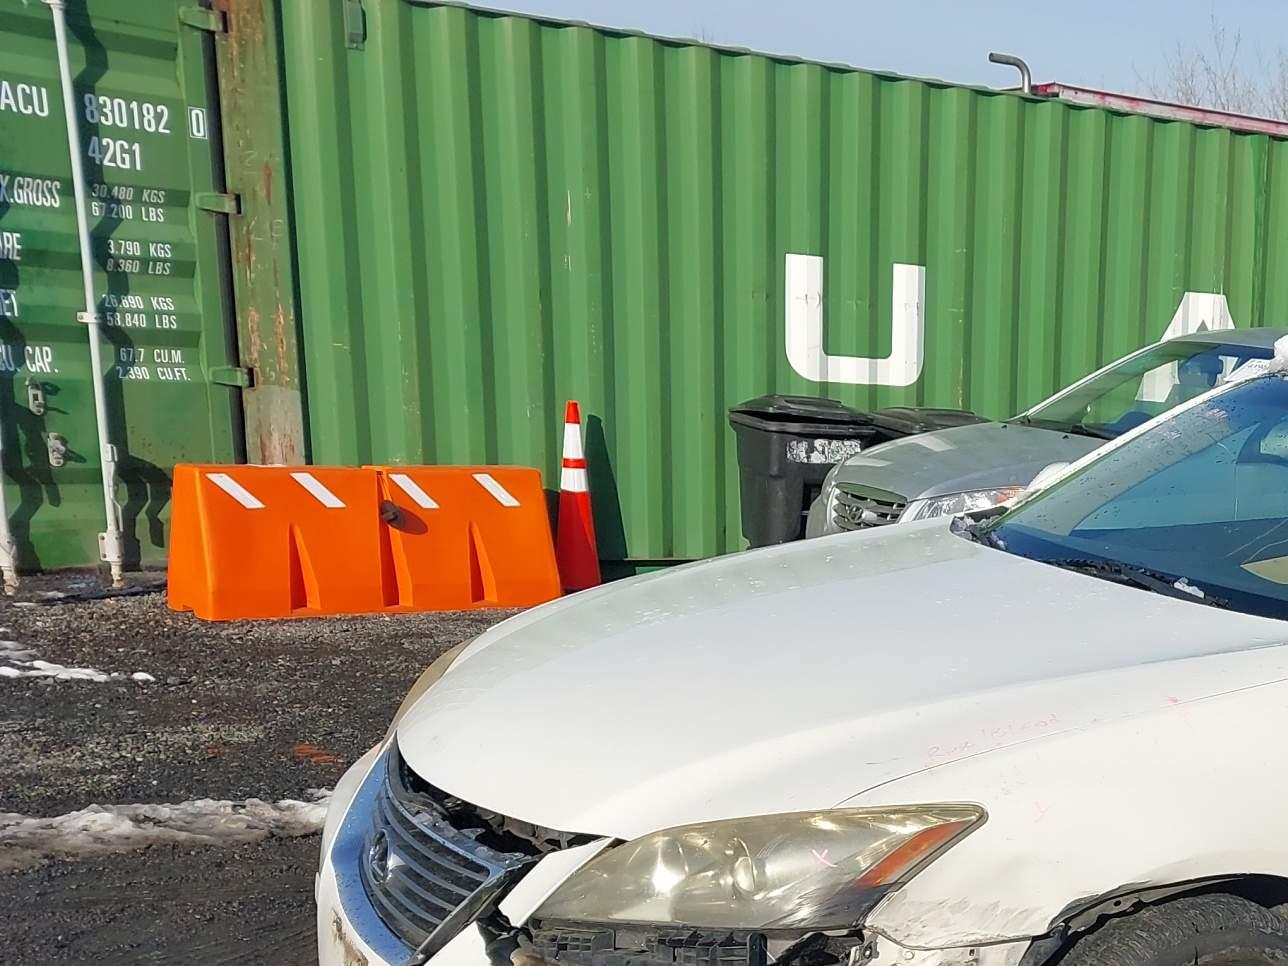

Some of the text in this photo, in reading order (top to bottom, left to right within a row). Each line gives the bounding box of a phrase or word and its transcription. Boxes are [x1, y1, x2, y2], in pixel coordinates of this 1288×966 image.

[0, 80, 206, 138] ACU 830182 0
[87, 135, 143, 171] 42G1
[91, 184, 166, 204] 30.480 KGS
[141, 206, 165, 223] LBS
[107, 239, 172, 258] 3.790 KGS
[106, 258, 171, 275] 8.360 LBS
[150, 296, 175, 312] KGS
[106, 311, 177, 329] 58.840 LBS
[785, 253, 926, 387] U
[24, 345, 59, 374] CAP.
[119, 347, 185, 364] 67.7 CU.M.
[156, 367, 191, 382] CU.FT.
